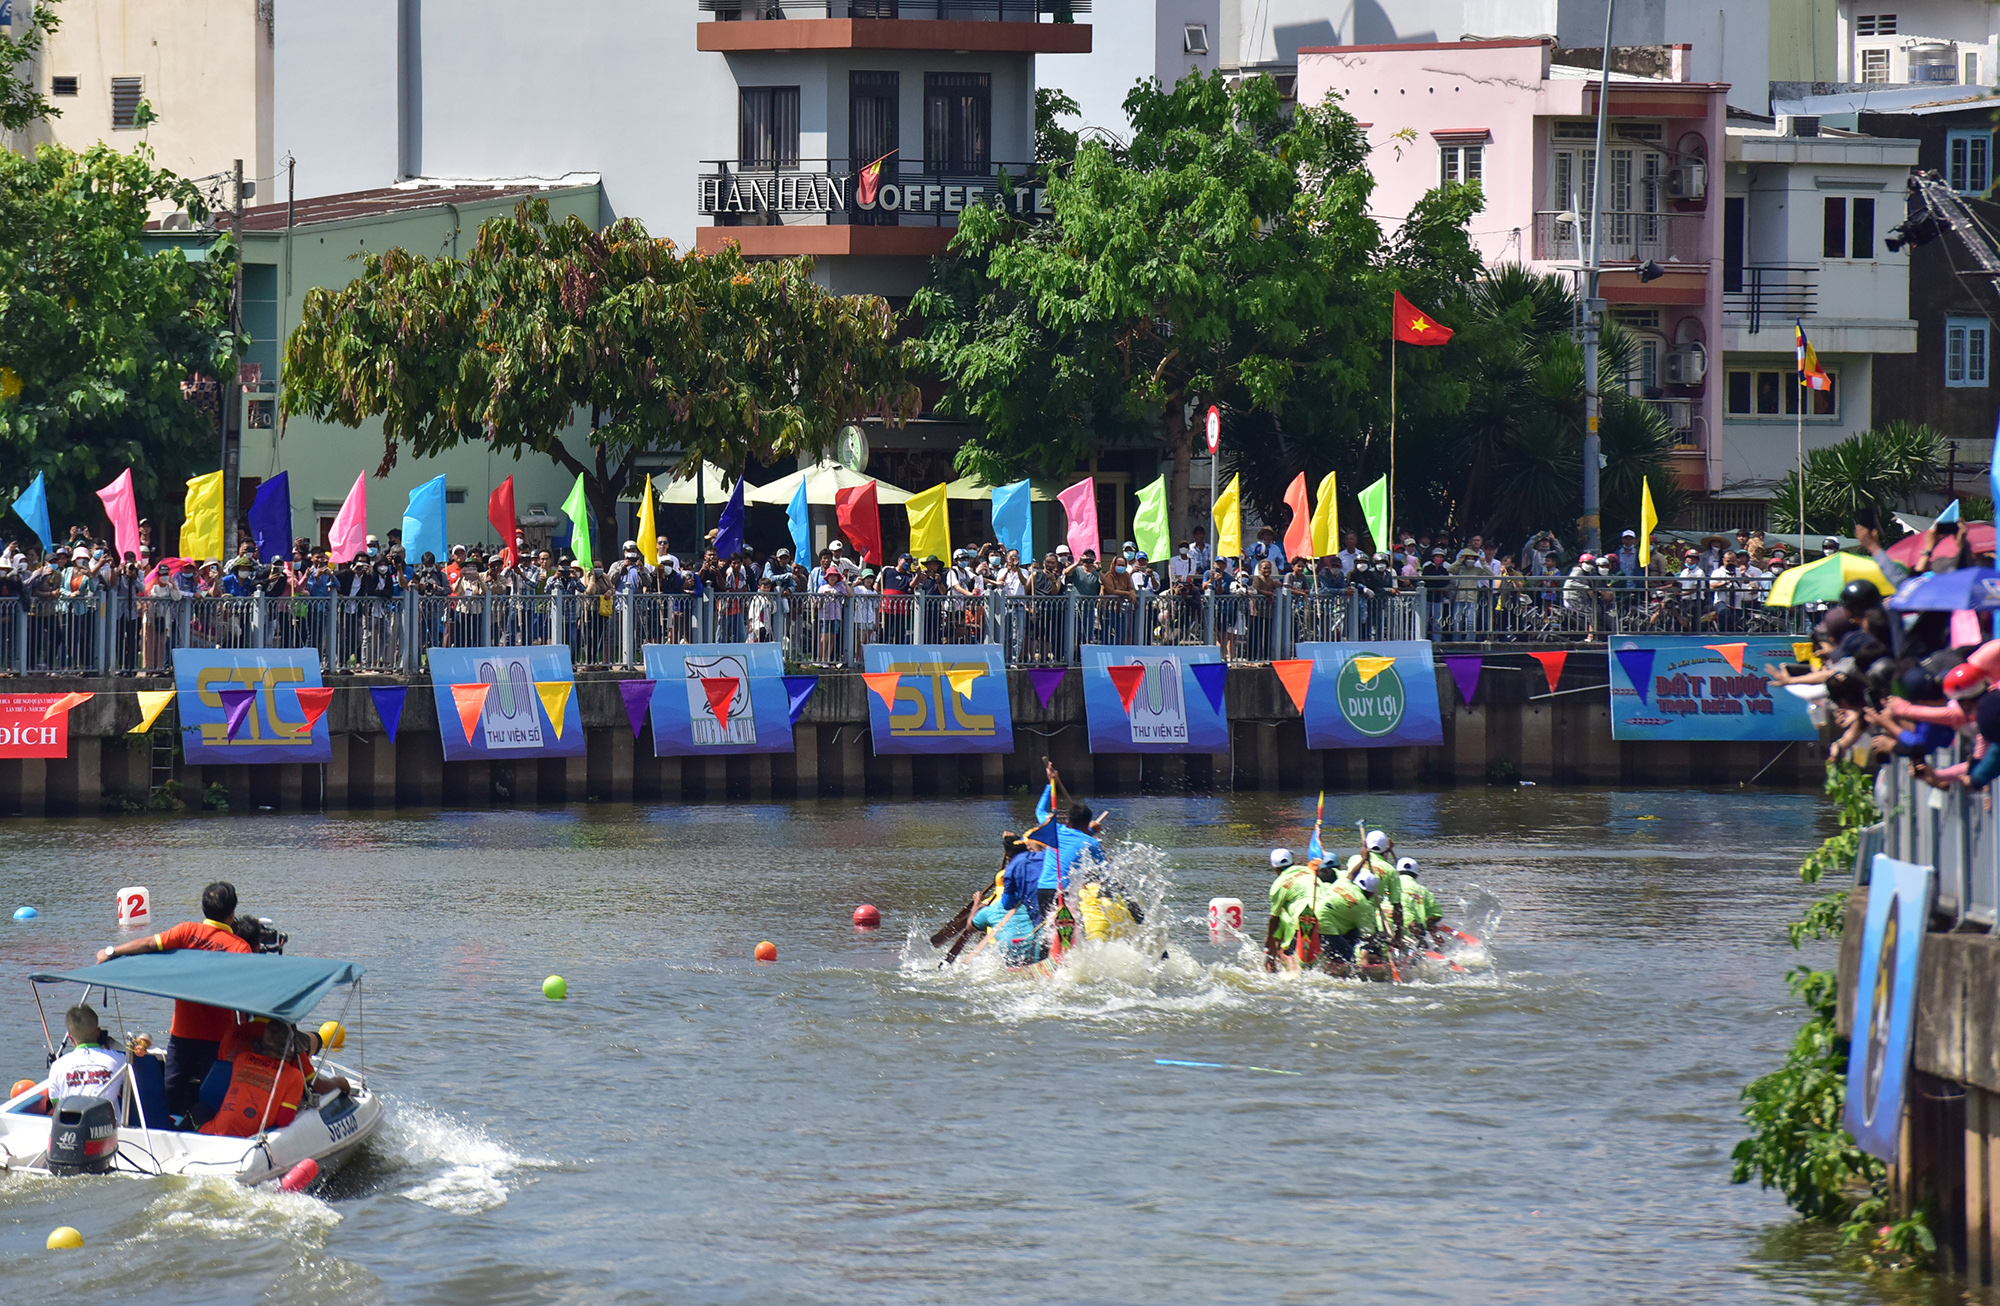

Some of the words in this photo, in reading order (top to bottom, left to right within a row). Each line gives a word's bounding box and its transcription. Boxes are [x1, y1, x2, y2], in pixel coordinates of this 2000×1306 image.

[1349, 697, 1373, 717] DUY
[1377, 694, 1398, 721] LỢI
[0, 722, 58, 745] ĐÍCH
[487, 729, 505, 743] THƯ
[507, 727, 527, 744] VIỆN
[528, 726, 540, 742] SỐ
[1133, 725, 1150, 738] THƯ
[1152, 723, 1172, 739] VIỆN
[1174, 723, 1186, 738] SỐ
[127, 894, 147, 918] 2
[1226, 905, 1242, 928] 3
[59, 1131, 77, 1144] 40
